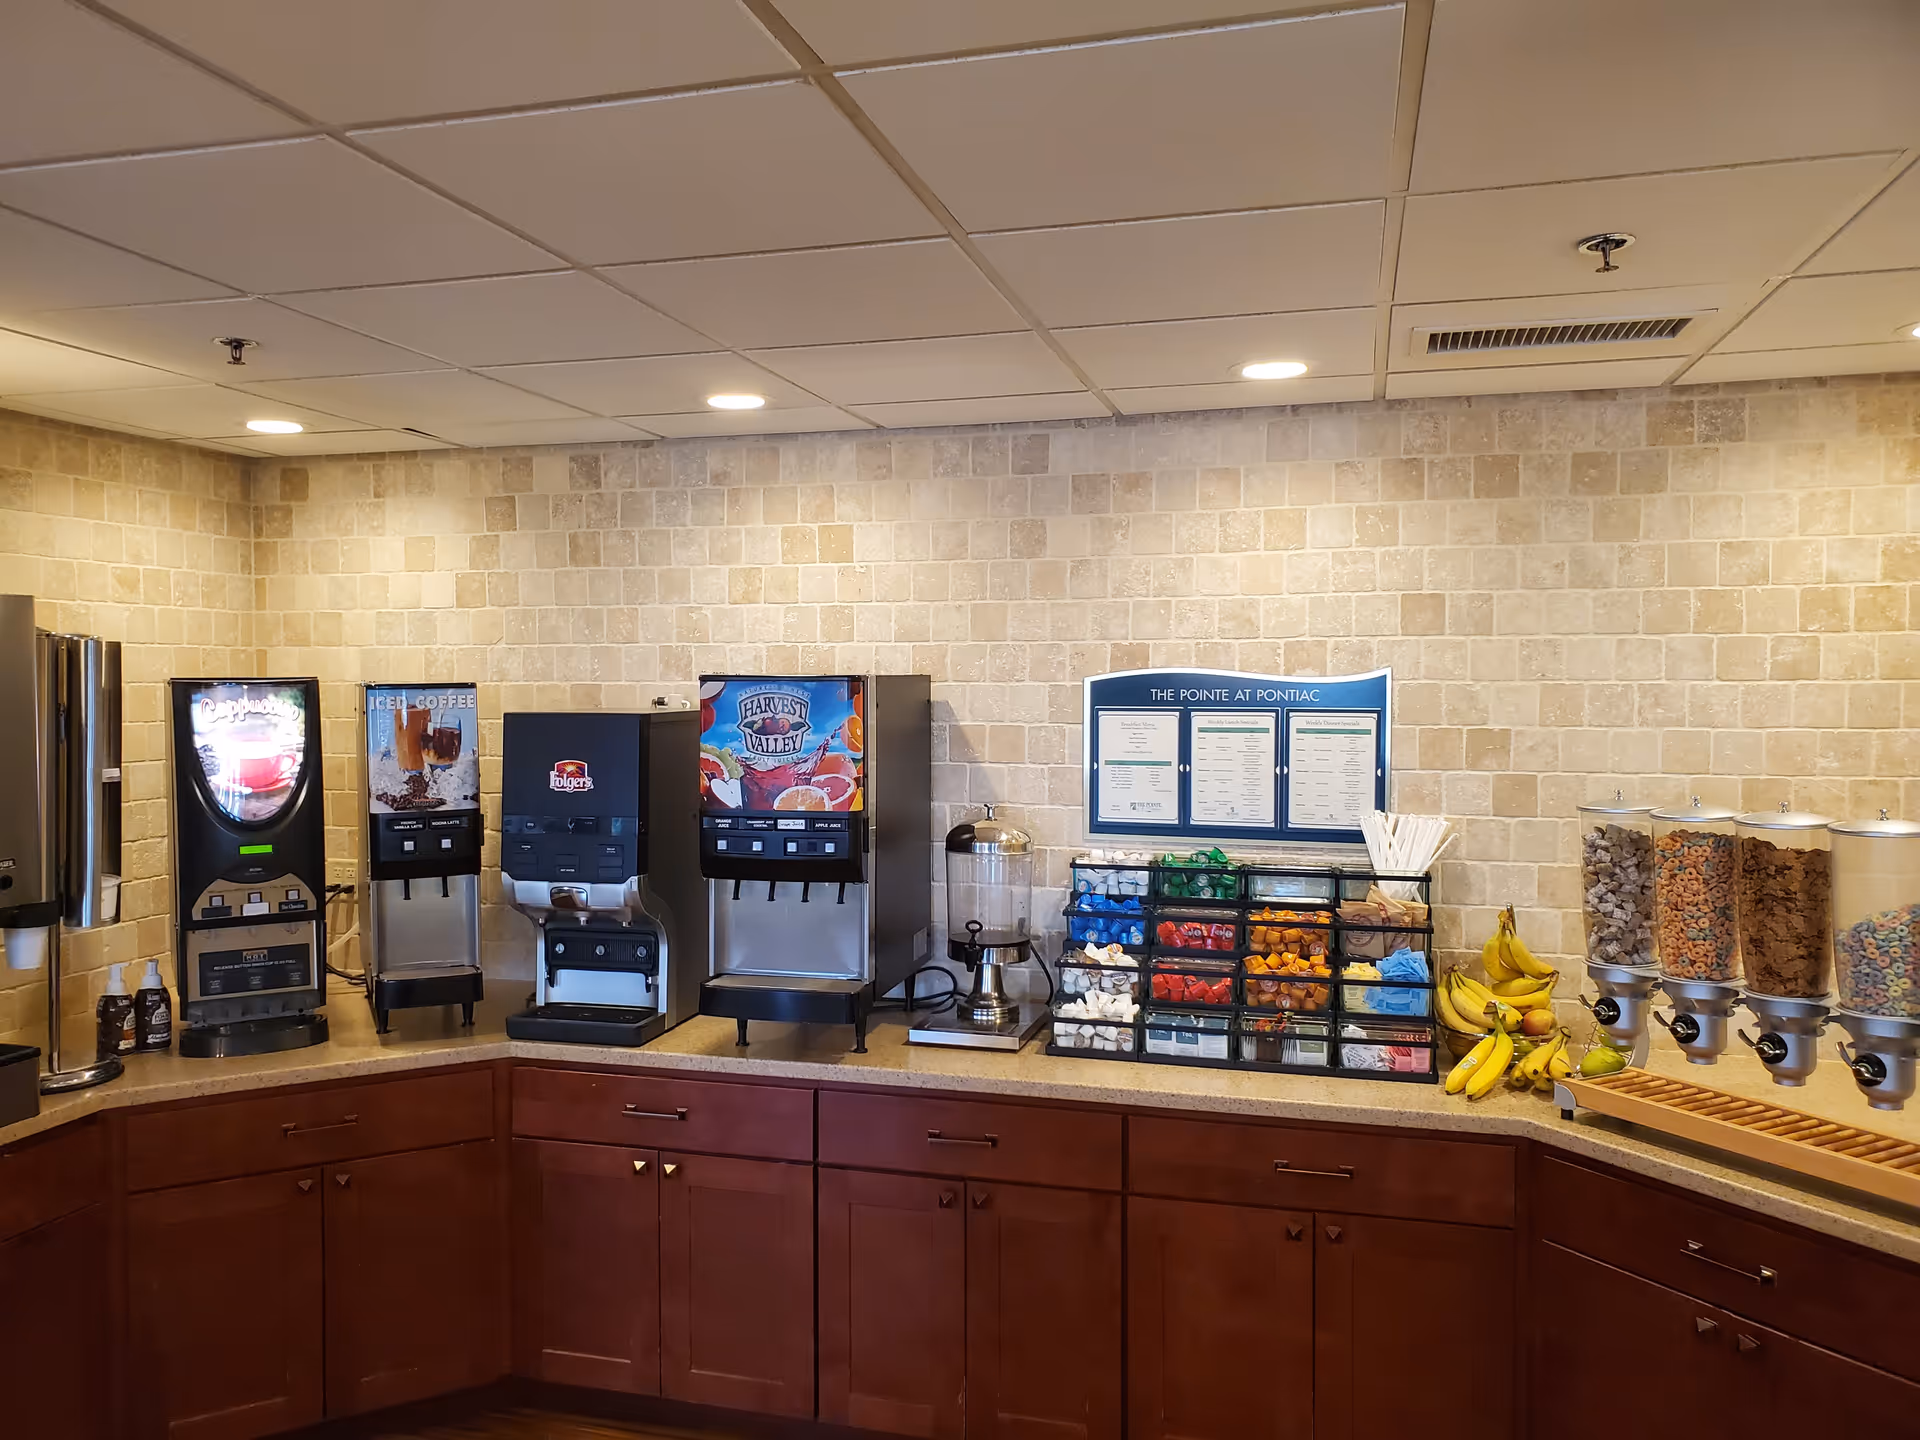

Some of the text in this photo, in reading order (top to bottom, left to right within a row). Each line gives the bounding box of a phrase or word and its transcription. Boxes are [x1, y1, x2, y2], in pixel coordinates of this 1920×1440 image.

[370, 694, 476, 710] ICED COFFEE
[1150, 689, 1321, 702] THE POINTE AT PONTIAC
[743, 696, 807, 720] HARVEST
[748, 734, 799, 754] VALLEY
[549, 771, 594, 792] Folgers
